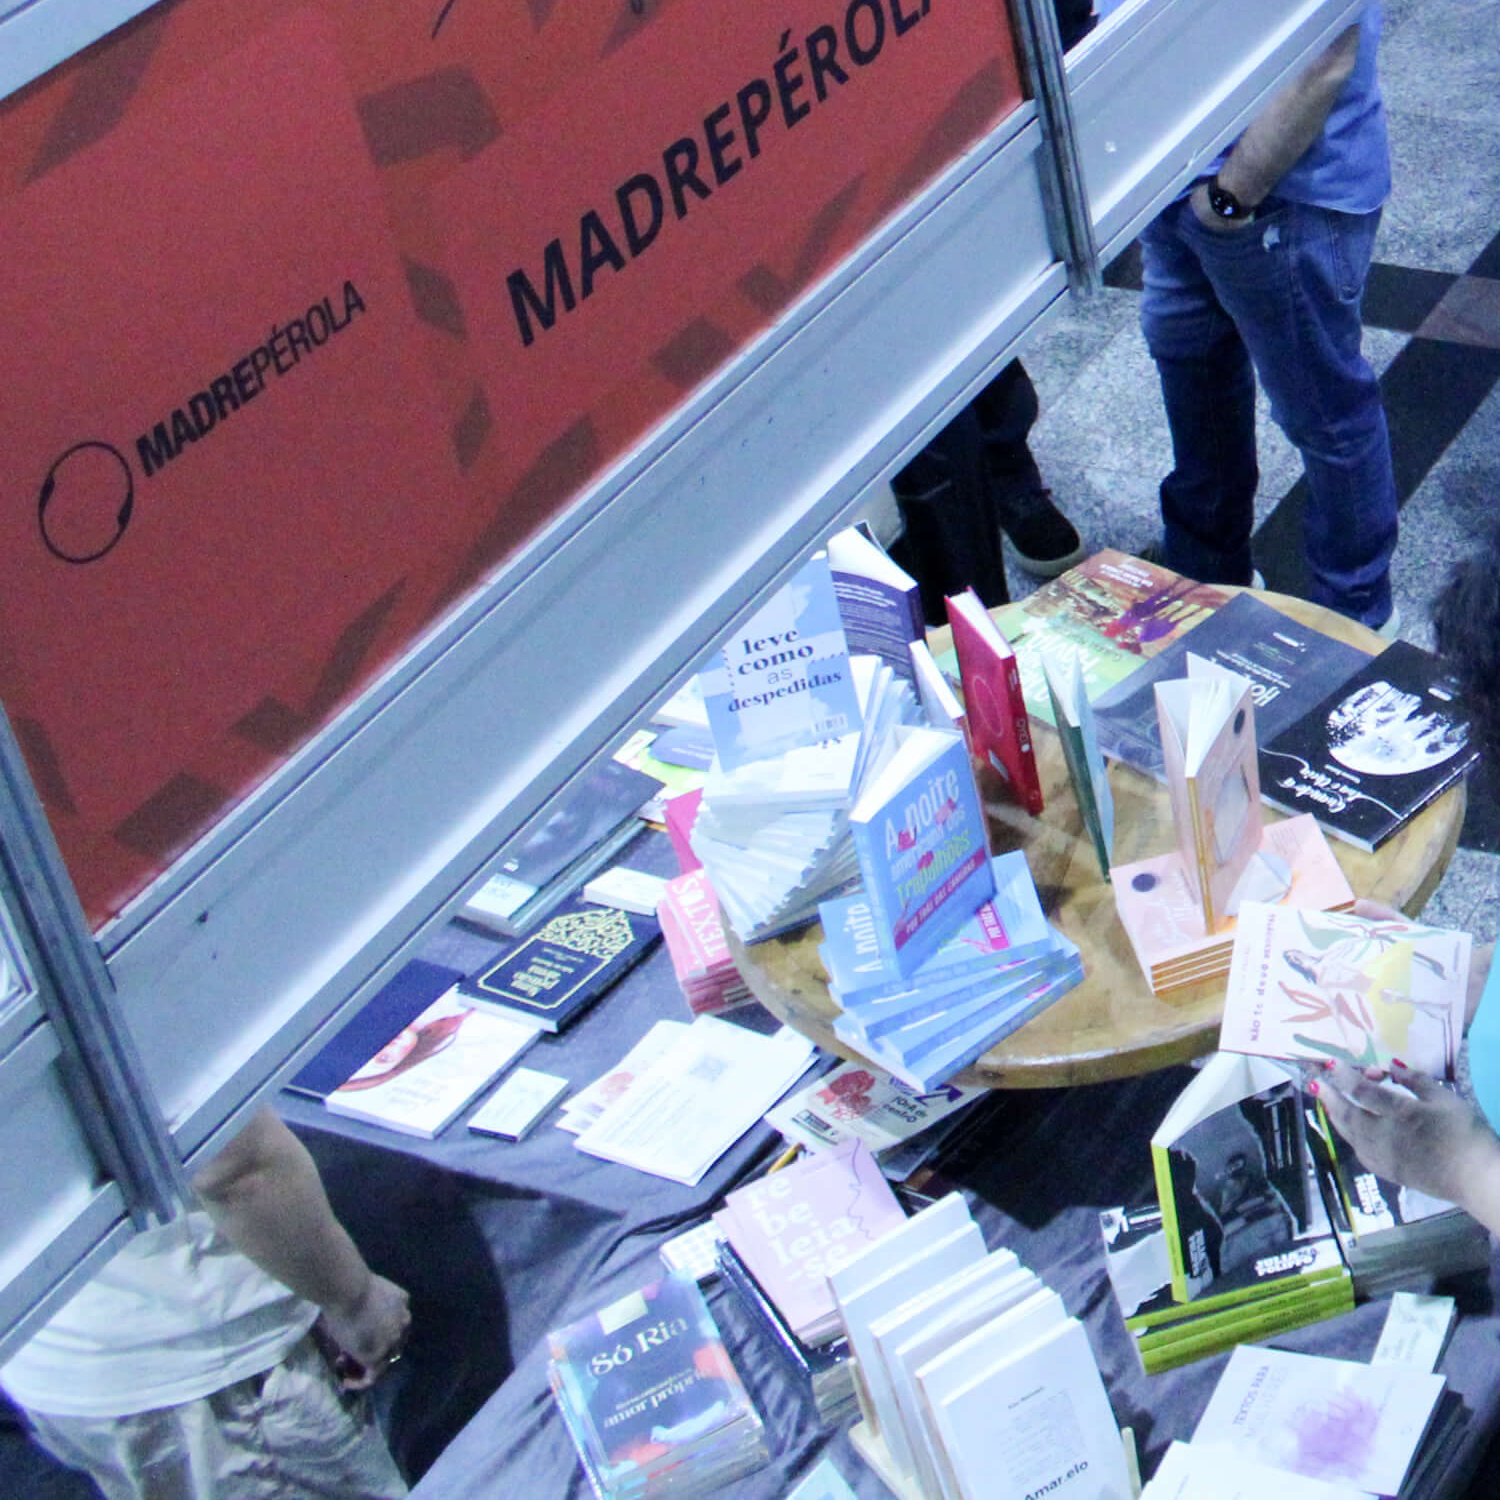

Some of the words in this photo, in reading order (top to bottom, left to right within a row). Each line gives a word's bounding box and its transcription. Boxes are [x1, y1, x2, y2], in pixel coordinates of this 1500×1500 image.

[135, 278, 368, 478] MADREPÉROLA
[737, 642, 815, 677] como
[742, 627, 800, 657] leve
[727, 669, 844, 714] despedidas
[766, 666, 795, 686] as
[884, 817, 899, 861] A
[905, 767, 961, 840] noite
[670, 872, 728, 959] TEXTOS
[852, 958, 885, 973] A
[745, 1176, 793, 1209] re
[752, 1202, 814, 1237] be
[767, 1216, 858, 1268] leia
[591, 1343, 634, 1376] Só
[635, 1317, 689, 1354] Ria
[1232, 1382, 1259, 1426] TEXTOS
